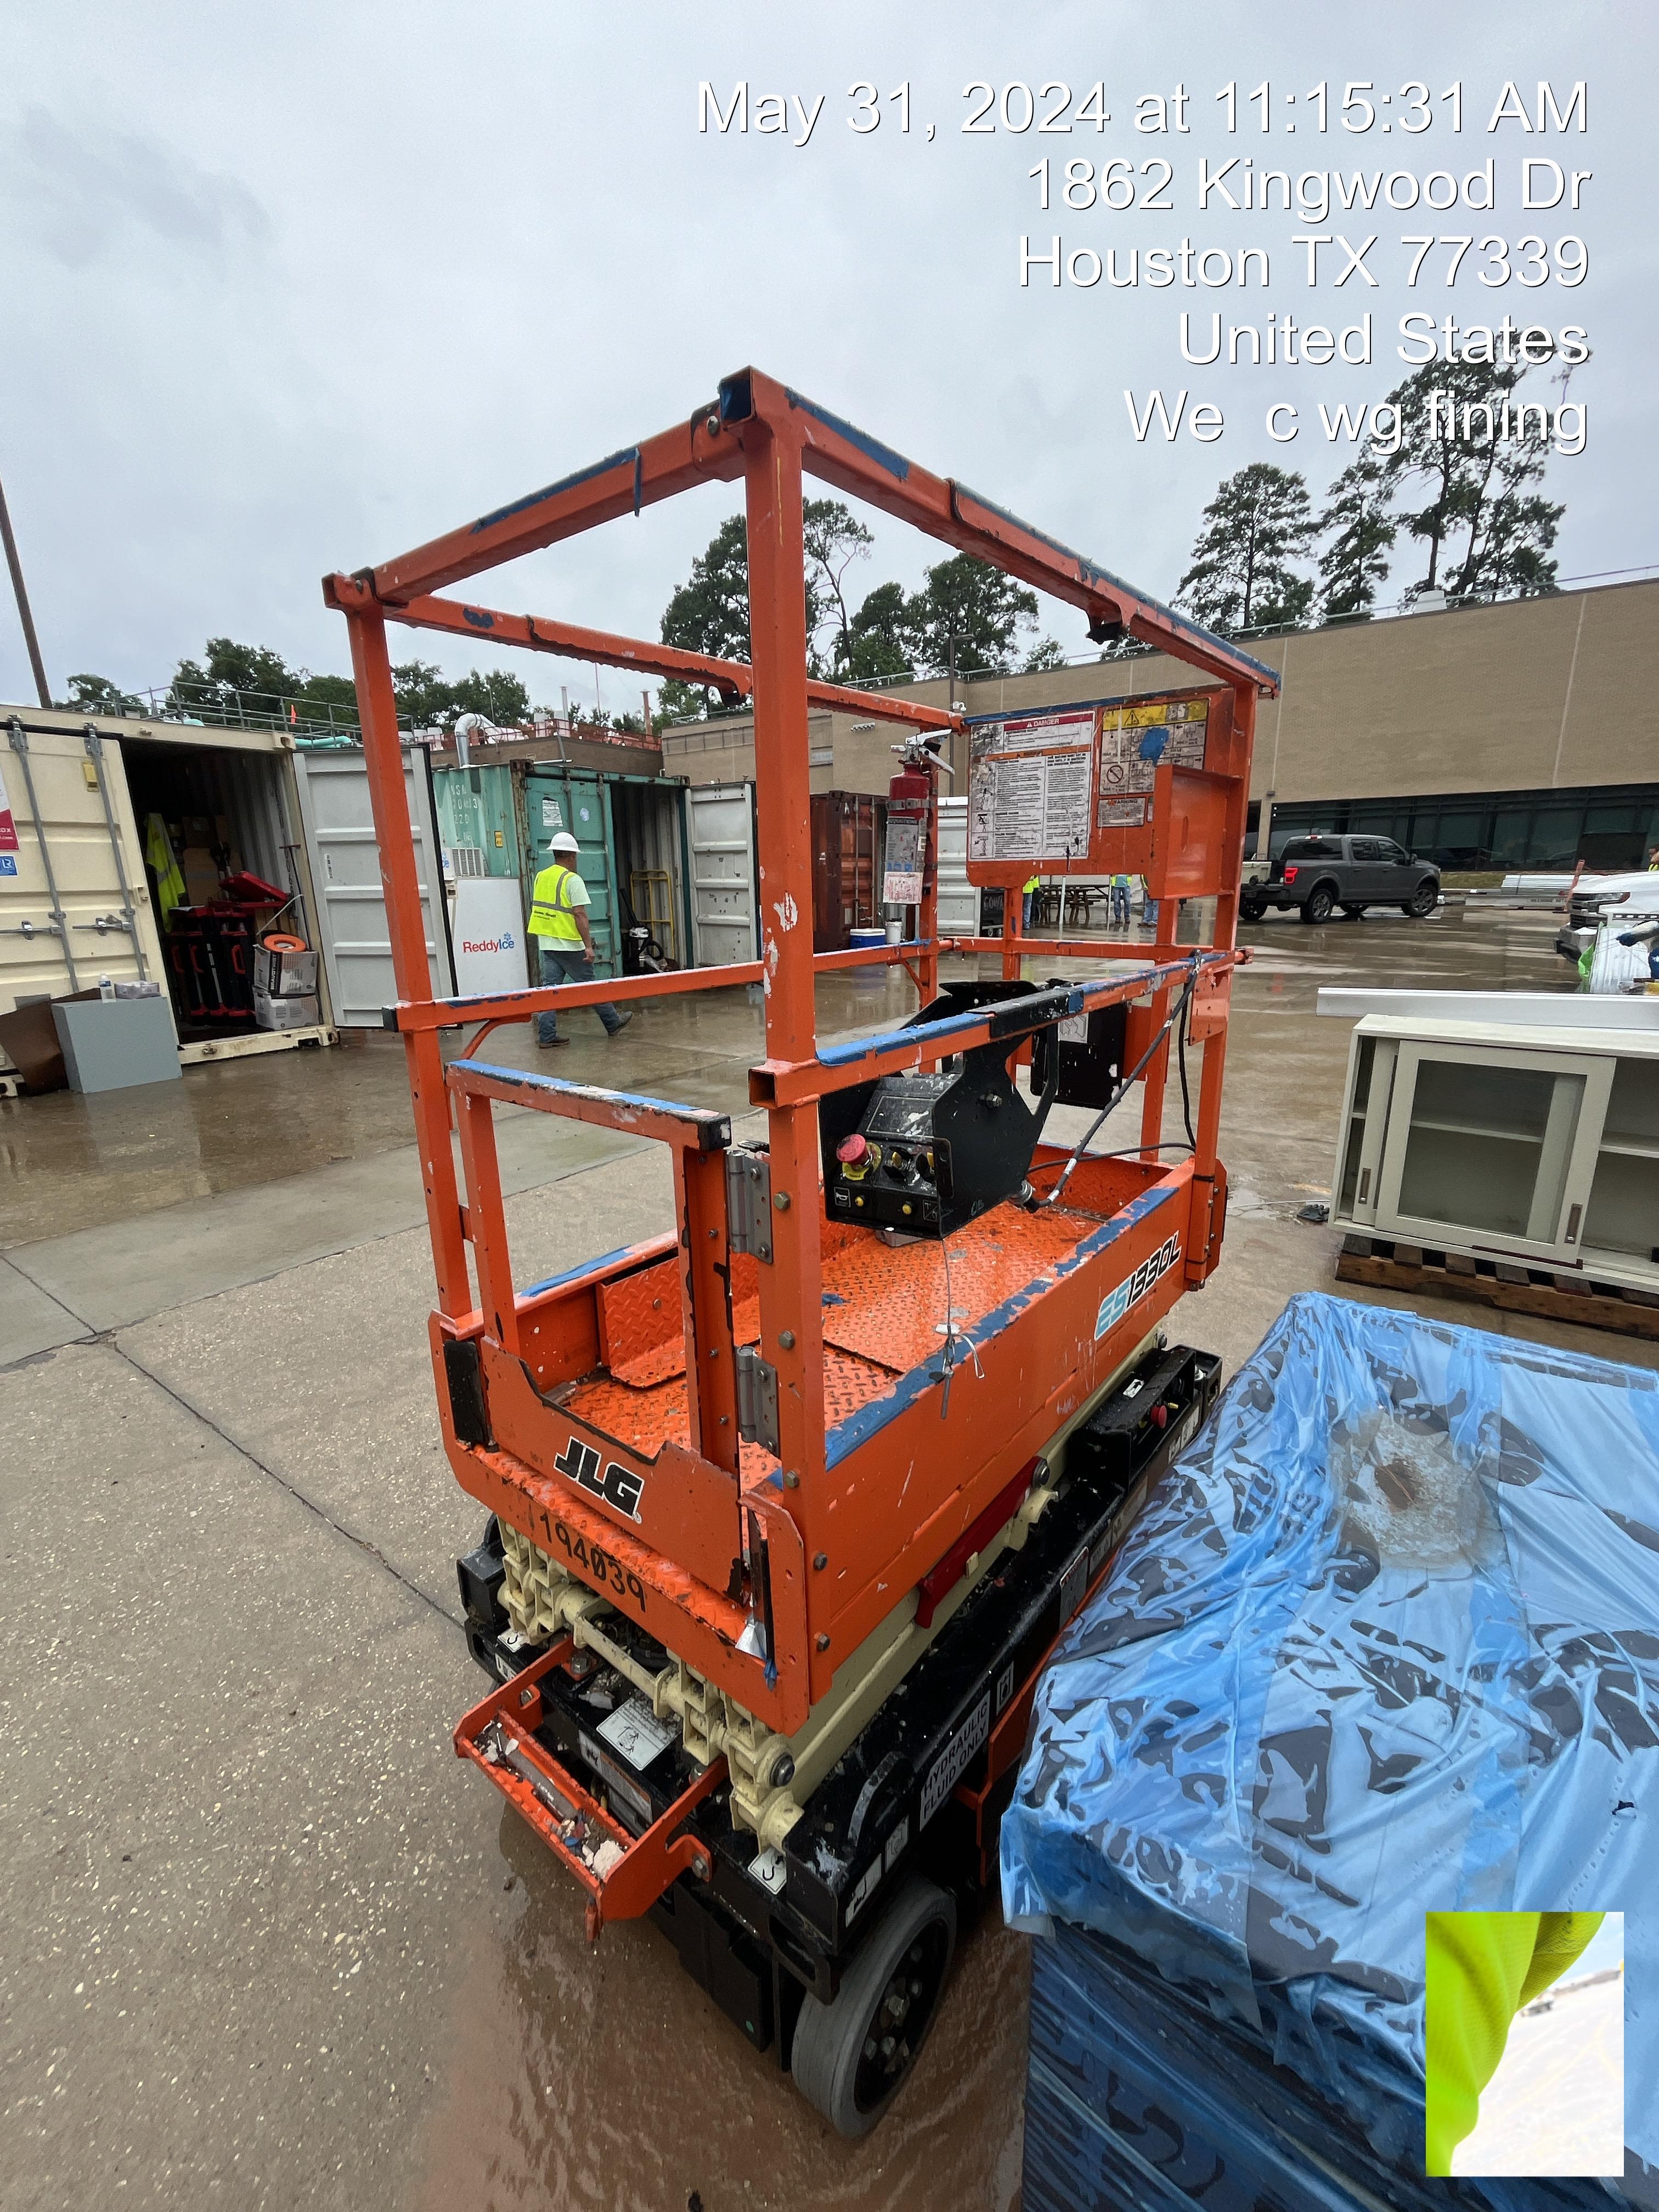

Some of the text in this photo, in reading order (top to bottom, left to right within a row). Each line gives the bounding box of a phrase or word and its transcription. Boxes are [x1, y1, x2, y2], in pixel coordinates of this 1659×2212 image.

[1034, 718, 1059, 727] DANGER
[462, 939, 515, 953] ReddyIce
[1094, 1229, 1182, 1341] ES1330L
[554, 1436, 645, 1520] JLG
[539, 1513, 647, 1613] 194039
[923, 1702, 988, 1798] HYDRAULIC
[923, 1720, 986, 1819] FLUID ONLY
